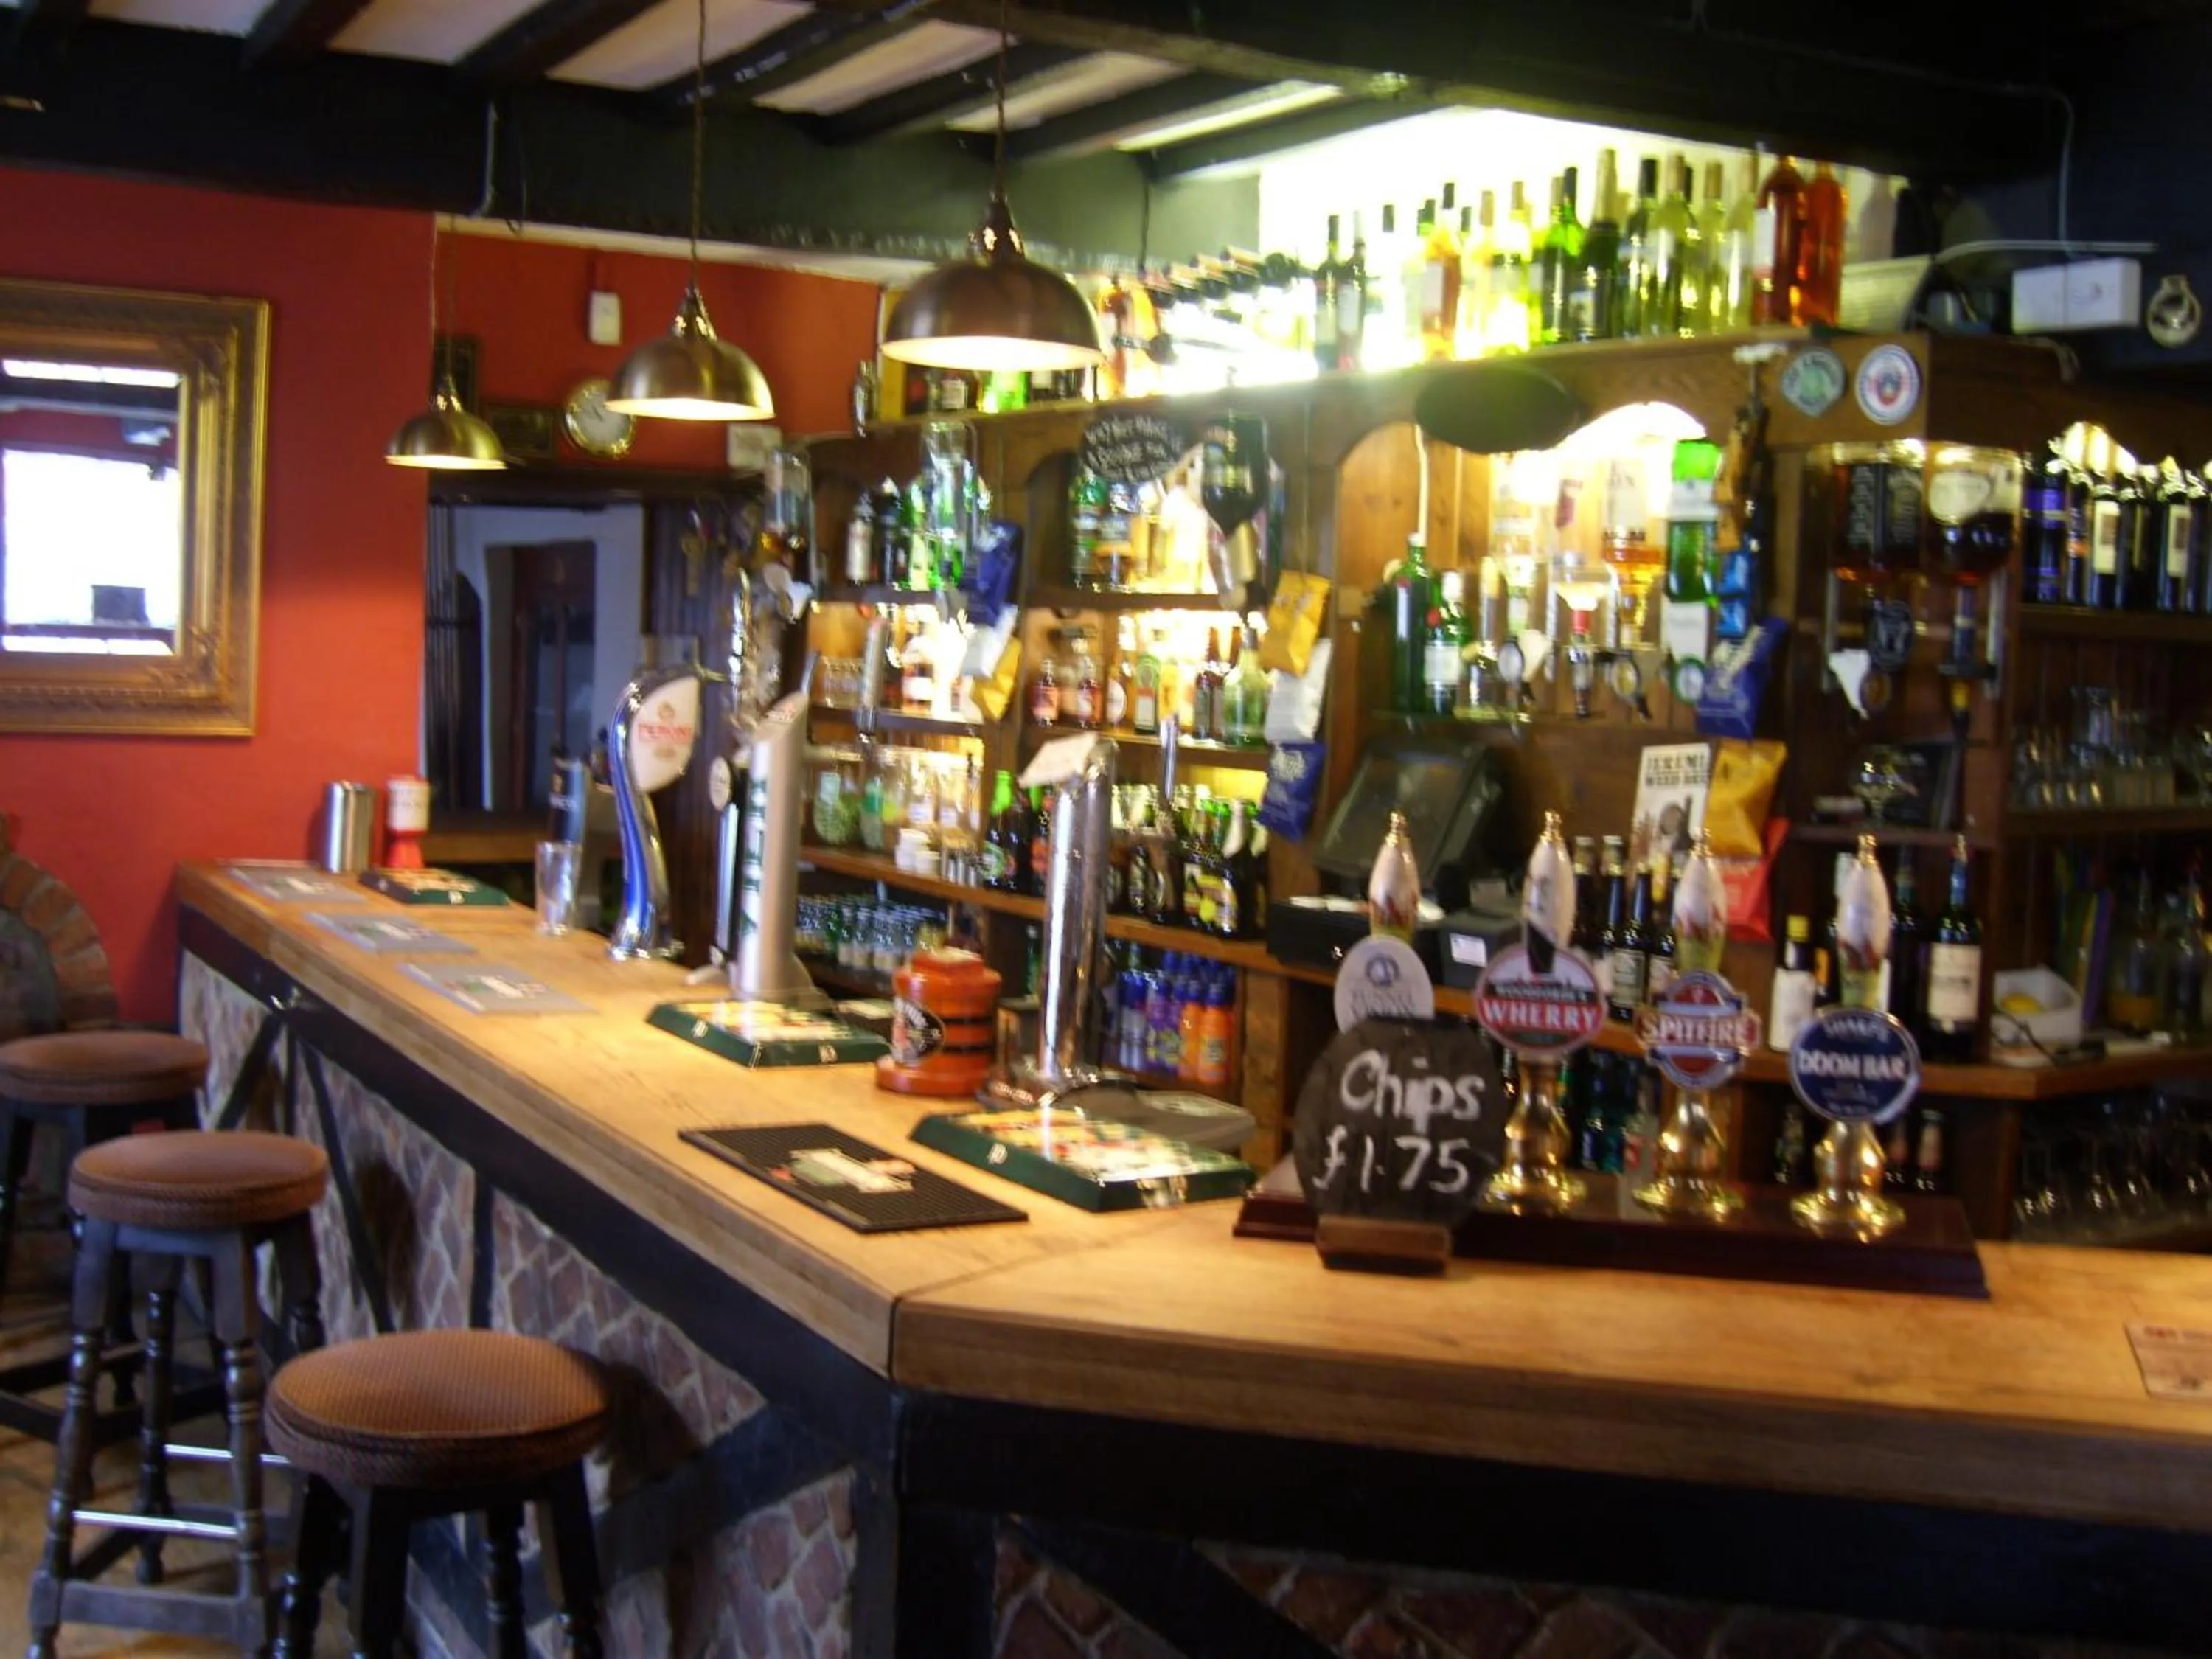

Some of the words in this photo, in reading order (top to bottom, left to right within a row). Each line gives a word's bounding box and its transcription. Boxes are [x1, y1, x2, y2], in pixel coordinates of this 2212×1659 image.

[1481, 998, 1597, 1032] WHERRY
[1638, 1012, 1747, 1046] SPITFIRE
[1798, 1049, 1861, 1079] DOOM
[1863, 1054, 1907, 1081] BAR
[1340, 1049, 1486, 1134] Chips
